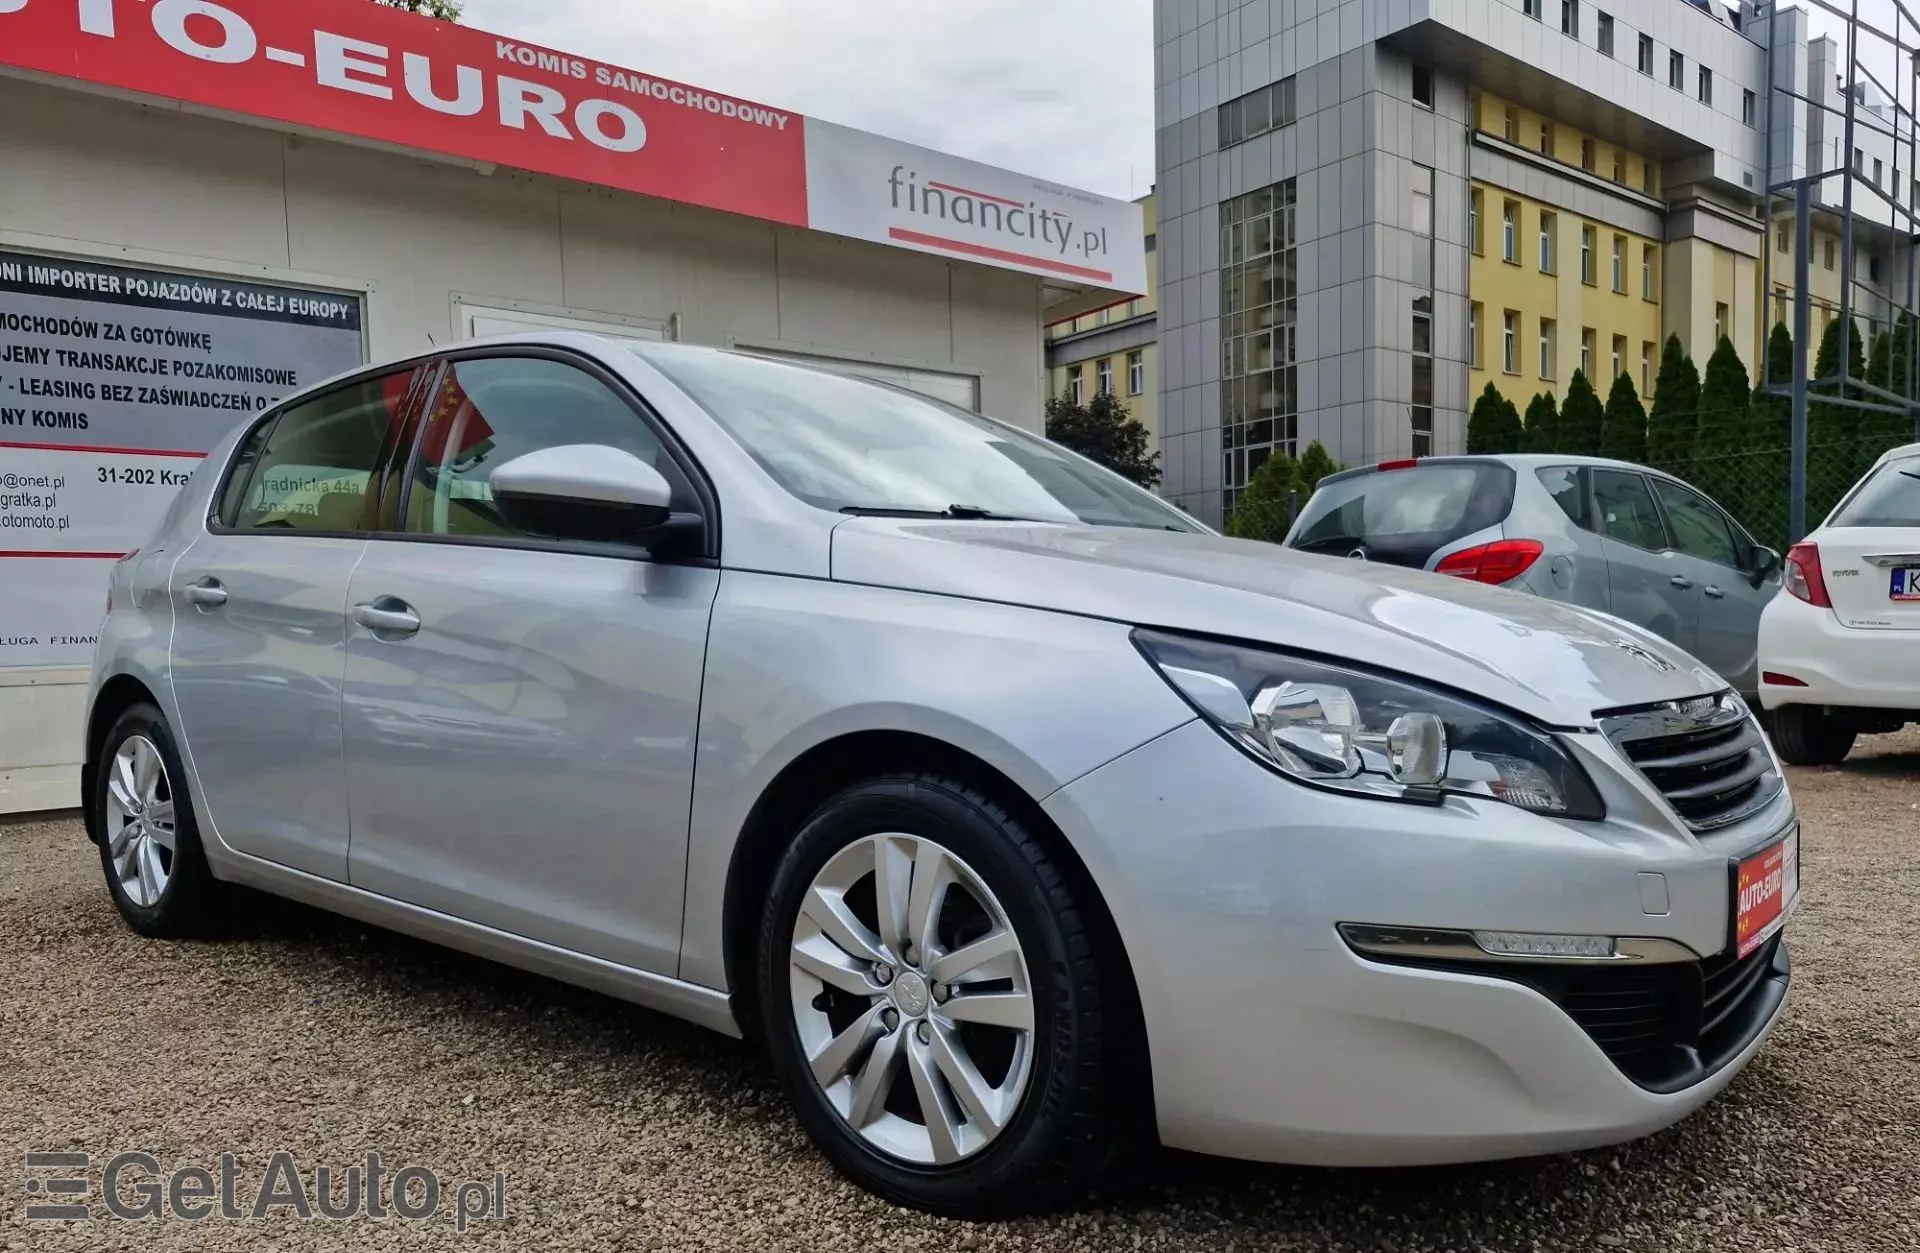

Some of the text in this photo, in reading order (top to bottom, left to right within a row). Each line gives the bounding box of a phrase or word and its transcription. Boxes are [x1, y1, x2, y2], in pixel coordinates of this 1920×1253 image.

[496, 41, 788, 131] KOMIS SAMOCHODOWY
[888, 166, 1107, 258] financity.pl
[28, 265, 121, 294] IMPORTER
[125, 277, 217, 305] POJAZDÓW
[221, 289, 232, 306] Z
[236, 291, 284, 312] CAŁEJ
[289, 297, 348, 320] EUROPY
[103, 323, 126, 342] ZA
[131, 326, 211, 353] GOTÓWKĘ
[56, 349, 168, 376] TRANSAKCJE
[173, 360, 297, 386] POZAKOMISOWE
[20, 377, 95, 400] LEASING
[102, 384, 133, 402] BEZ
[138, 385, 251, 411] ZAŚWIADCZEŃ
[33, 410, 88, 430] KOMIS
[97, 467, 193, 486] 31-202 Kra
[1739, 866, 1782, 916] AUTO-EURO
